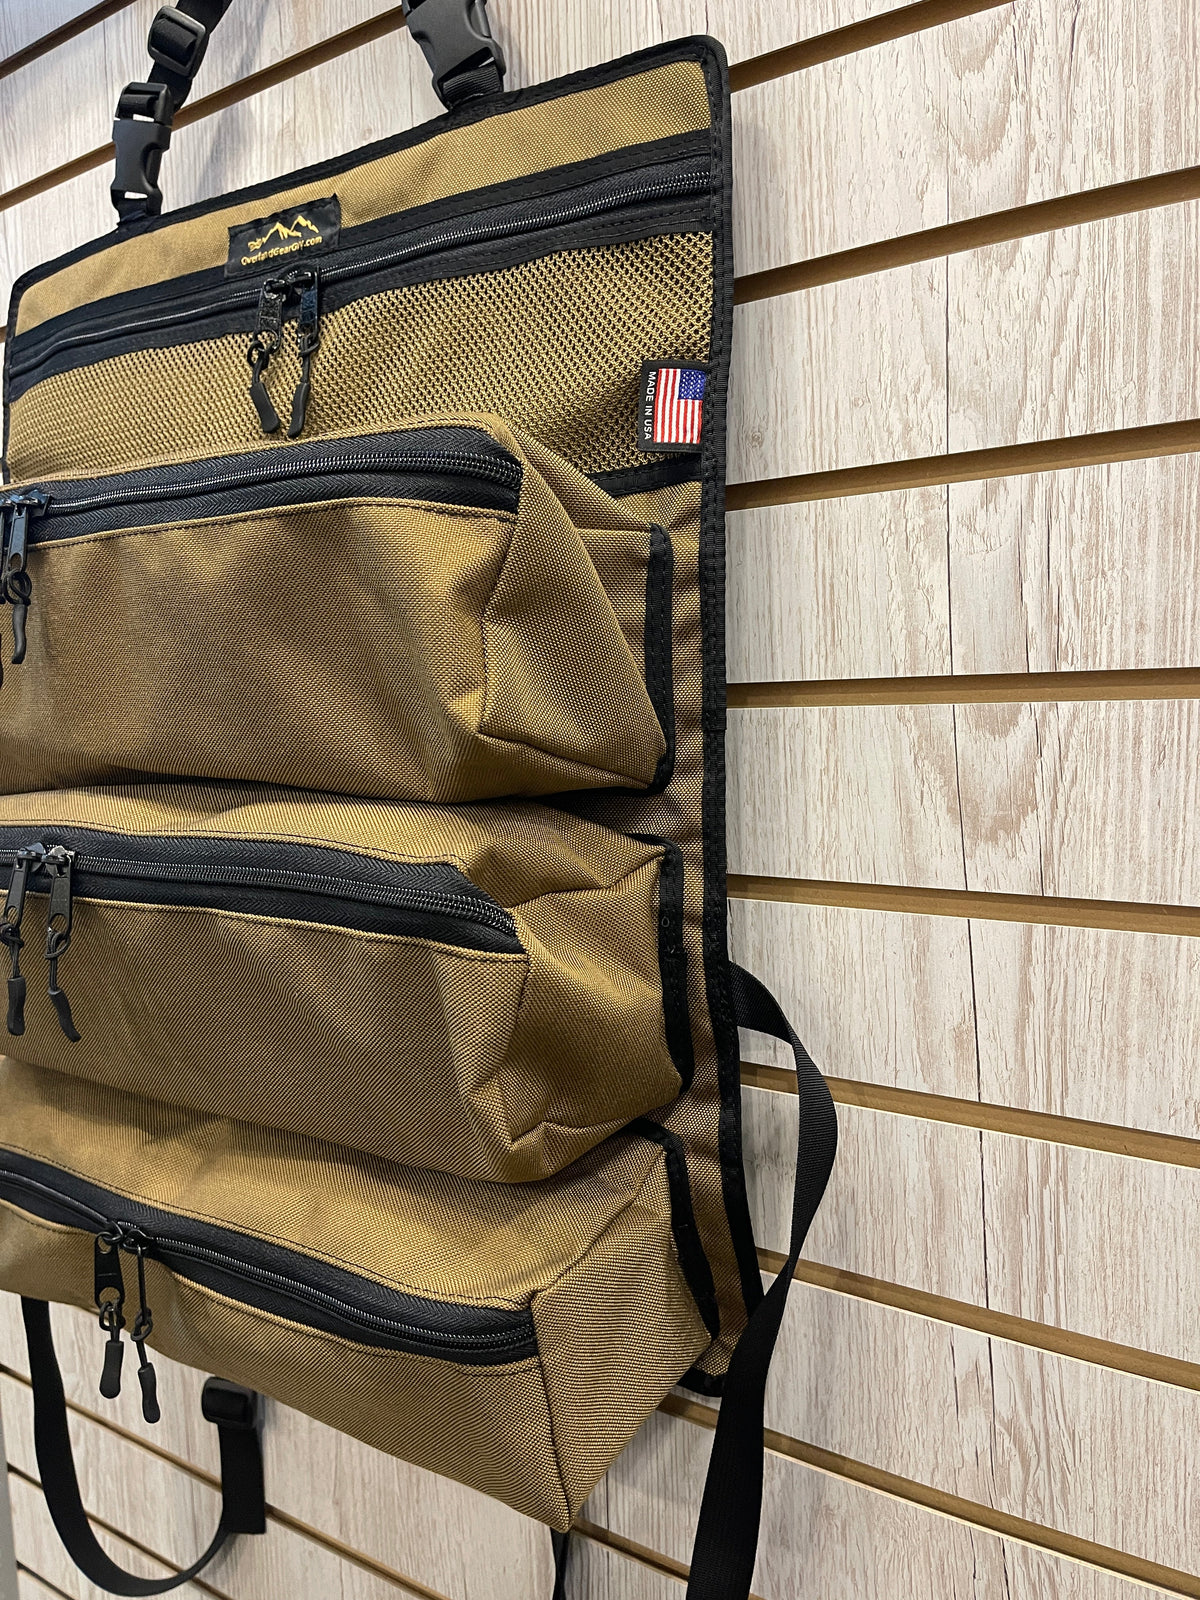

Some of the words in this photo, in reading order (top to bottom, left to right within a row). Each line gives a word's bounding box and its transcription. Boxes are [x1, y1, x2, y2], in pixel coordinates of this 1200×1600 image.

[645, 371, 657, 402] MADE
[644, 405, 653, 416] IN
[643, 419, 653, 440] USA
